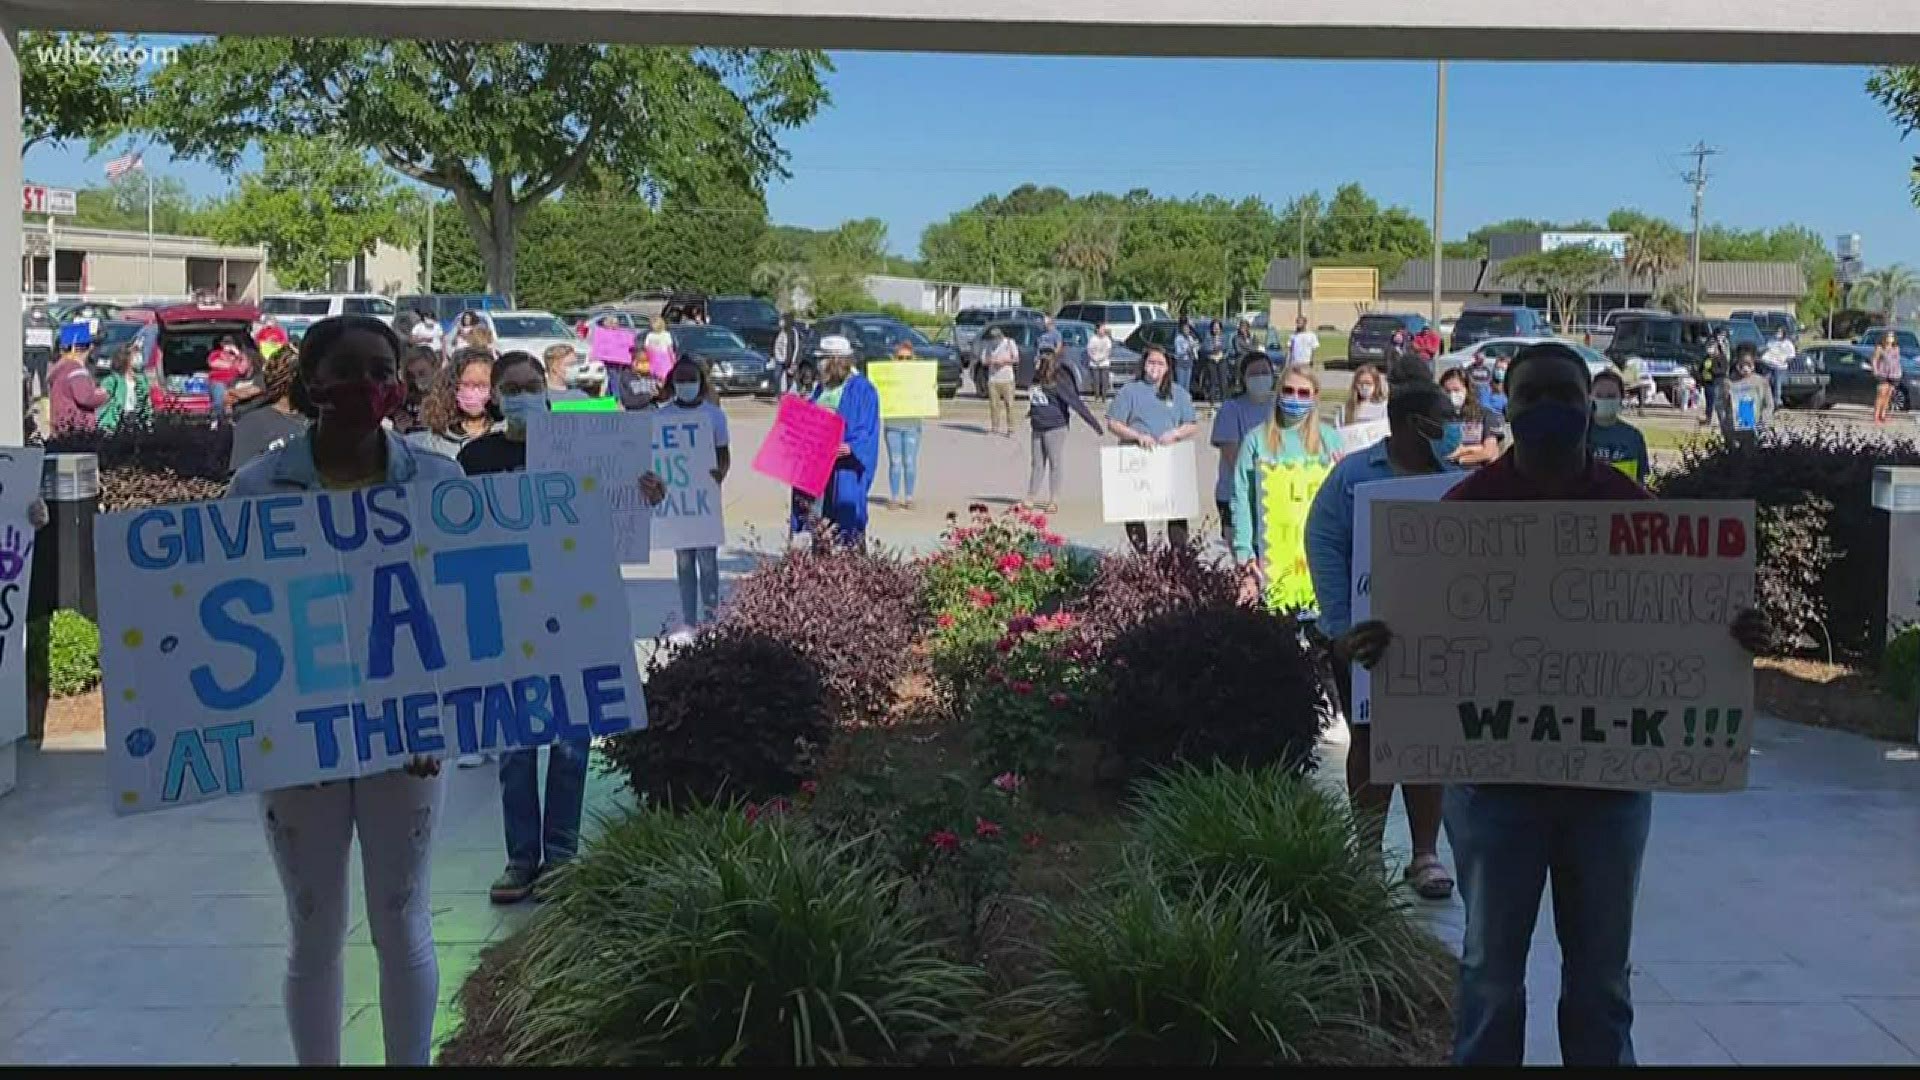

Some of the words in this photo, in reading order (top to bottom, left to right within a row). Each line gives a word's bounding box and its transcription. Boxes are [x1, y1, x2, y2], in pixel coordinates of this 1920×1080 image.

[127, 496, 306, 569] GIVE
[317, 486, 412, 551] US
[431, 472, 578, 535] OUR
[1552, 510, 1598, 556] BE
[1609, 511, 1746, 558] AFRAID
[189, 543, 531, 710] SEAT
[1446, 571, 1517, 623] OF
[1385, 633, 1492, 697] LET
[162, 720, 254, 801] AT
